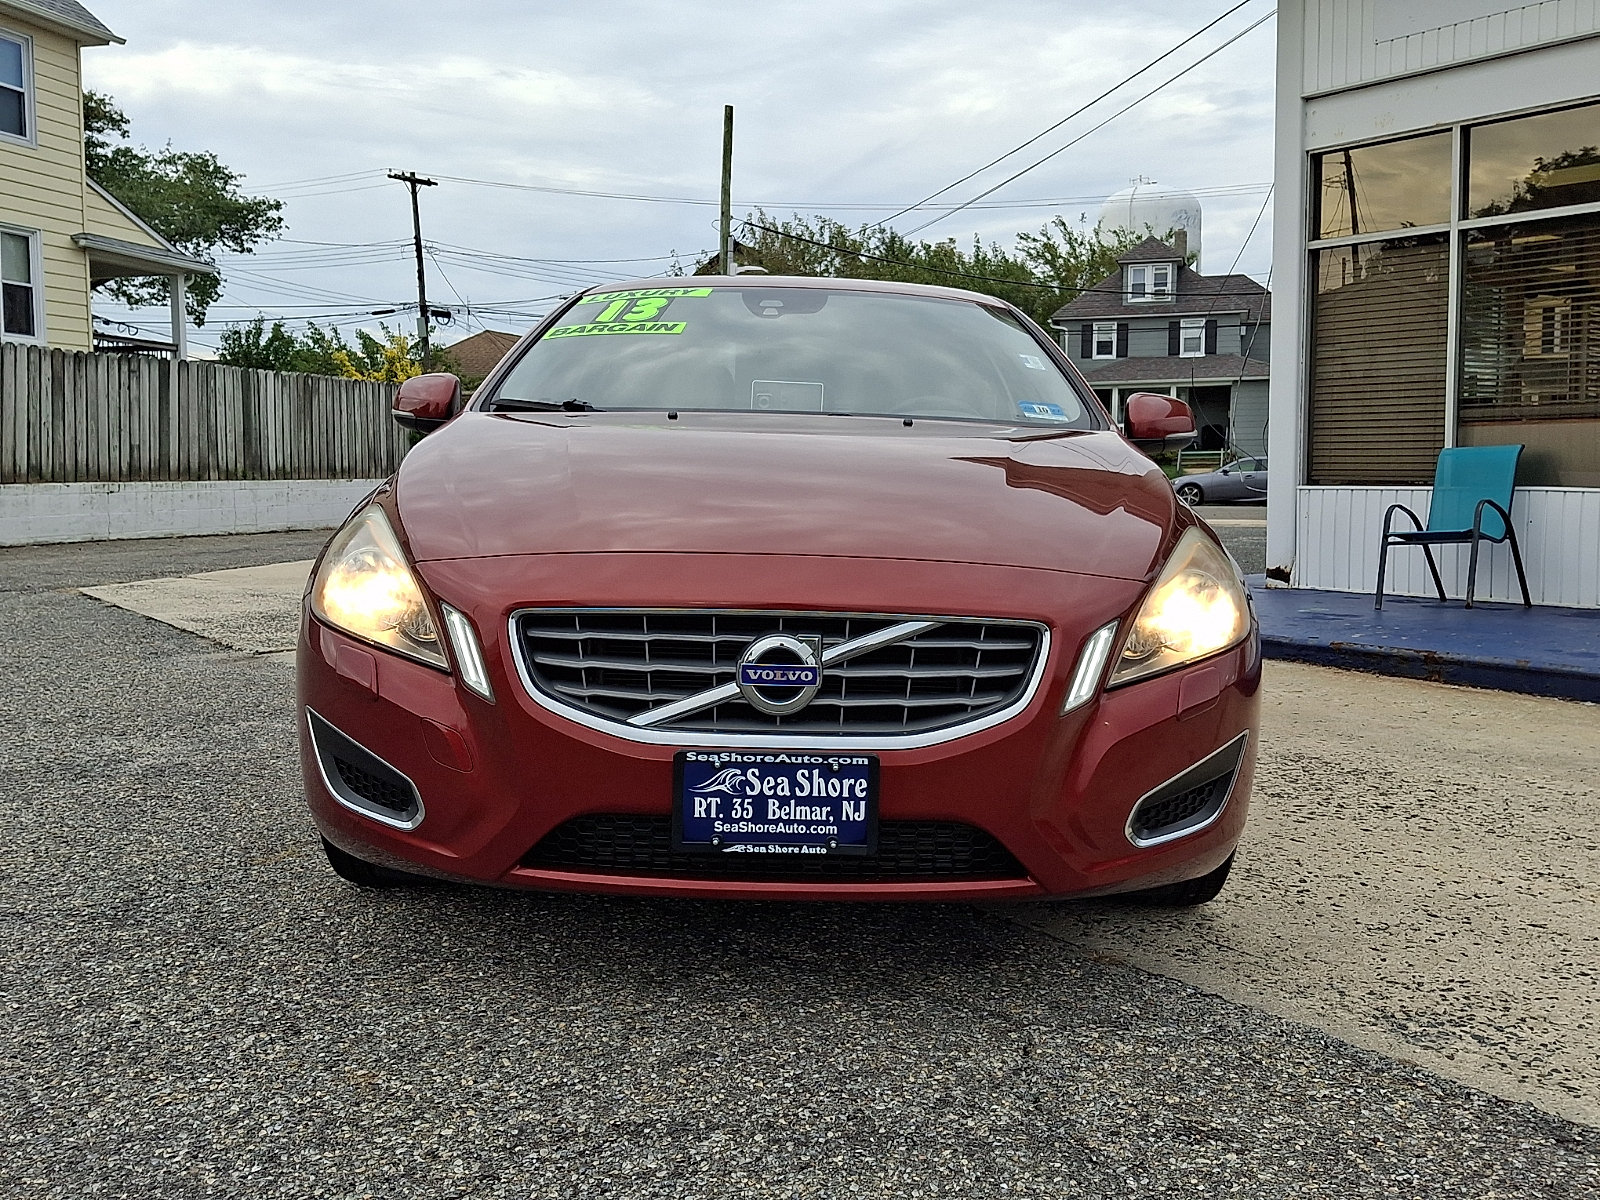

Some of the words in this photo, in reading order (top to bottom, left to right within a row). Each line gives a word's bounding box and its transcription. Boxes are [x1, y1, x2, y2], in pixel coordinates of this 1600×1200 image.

[587, 289, 696, 301] LUXURY
[595, 297, 669, 322] 13
[550, 323, 679, 336] BARGAIN
[746, 669, 813, 681] VOLVO
[686, 752, 869, 765] SeaShoreAuto.com
[745, 768, 791, 796] Sea
[795, 768, 868, 797] Shore
[693, 797, 723, 818] RT.
[731, 798, 753, 819] 35
[767, 799, 833, 823] Belmar,
[842, 800, 866, 821] NJ
[714, 821, 838, 834] SeaShoreAuto.com
[746, 845, 767, 853] Sea
[768, 845, 799, 854] Shore
[801, 845, 827, 854] Auto
